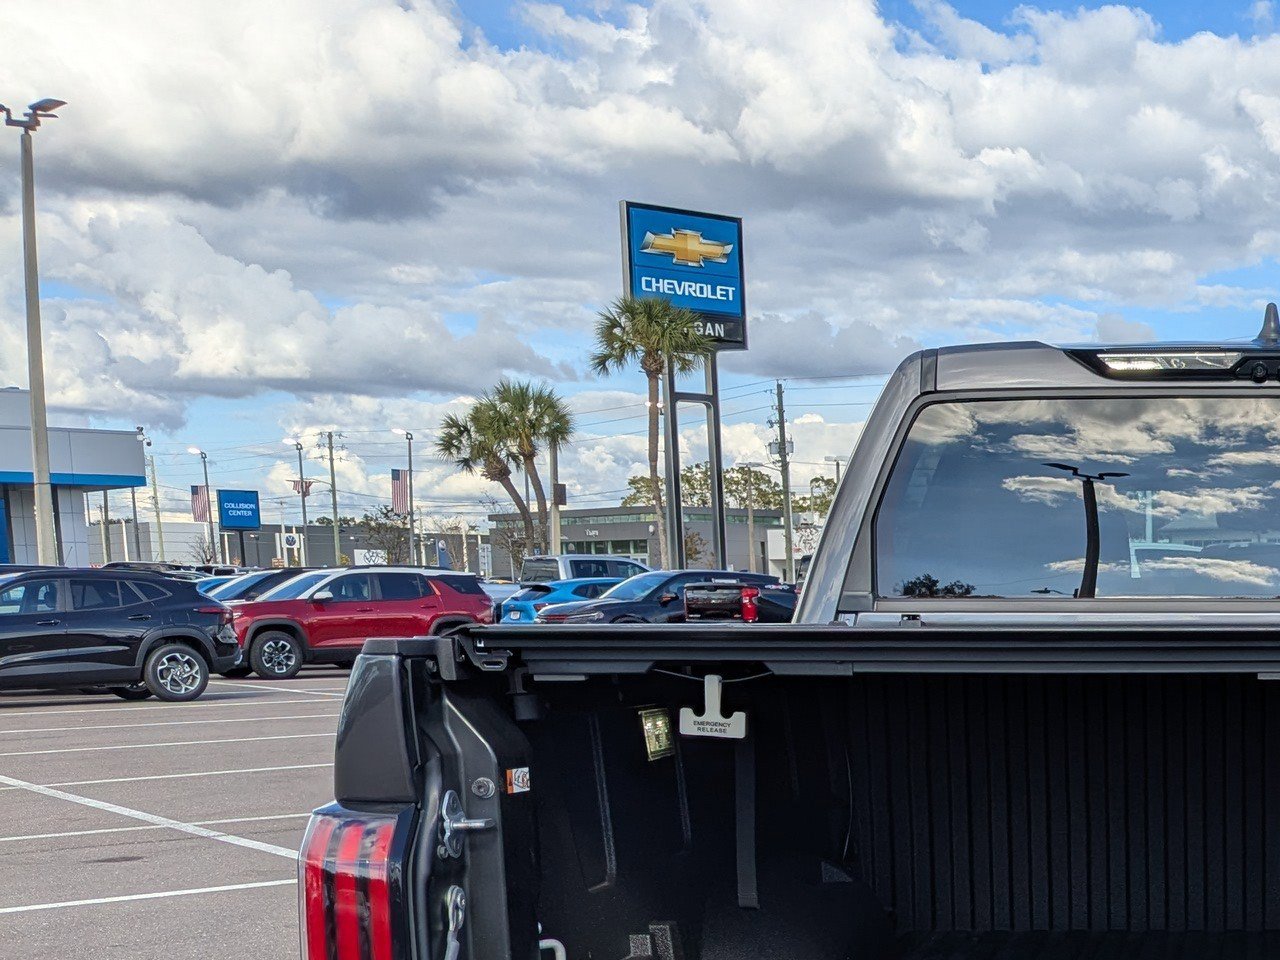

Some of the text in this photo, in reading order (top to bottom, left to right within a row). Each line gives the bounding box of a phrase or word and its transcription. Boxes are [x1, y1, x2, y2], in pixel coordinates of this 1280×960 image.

[641, 276, 736, 301] CHEVROLET
[683, 321, 725, 338] GAN
[223, 502, 256, 510] COLLISION
[228, 509, 253, 517] CENTER
[693, 720, 732, 728] EMERGENCY
